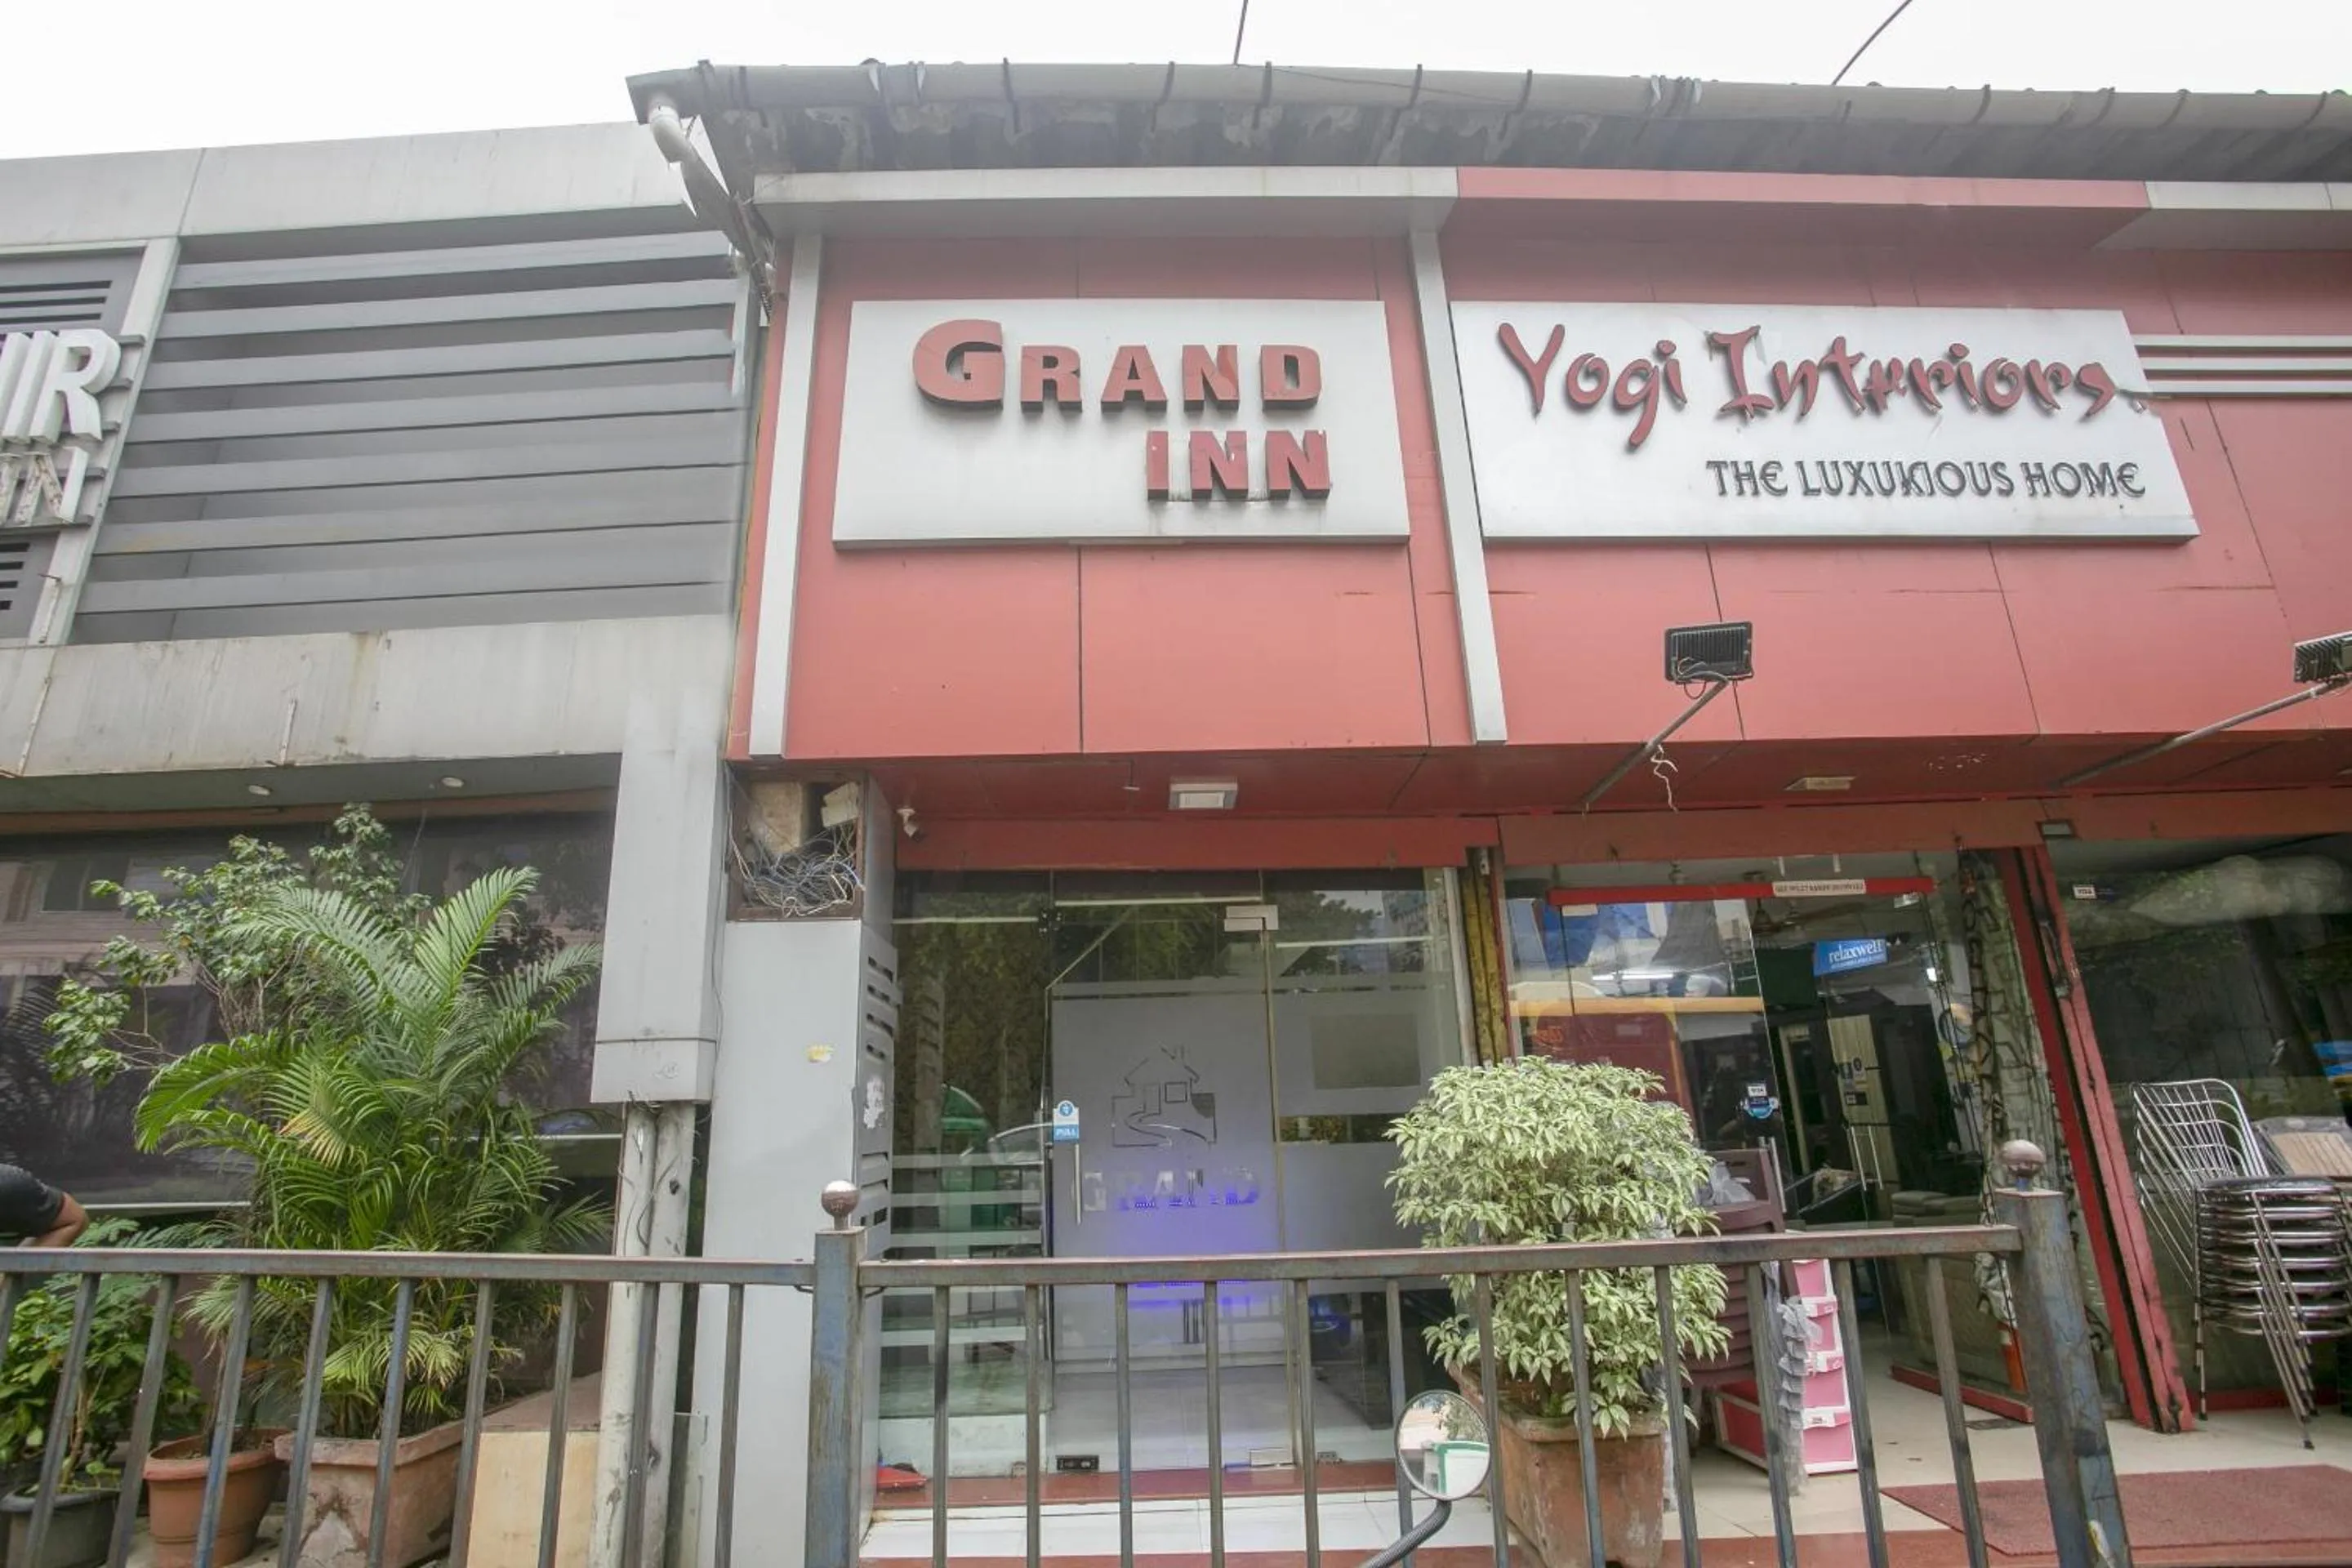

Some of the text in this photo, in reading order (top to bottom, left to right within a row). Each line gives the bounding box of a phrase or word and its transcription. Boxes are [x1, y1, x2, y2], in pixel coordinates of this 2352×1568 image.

[912, 318, 1323, 413] GRAND
[1497, 323, 1687, 448] Yogi
[1146, 430, 1330, 501] INN
[1706, 460, 1788, 497] THE
[2020, 461, 2147, 498] HOME
[1829, 938, 1883, 964] relaxwell
